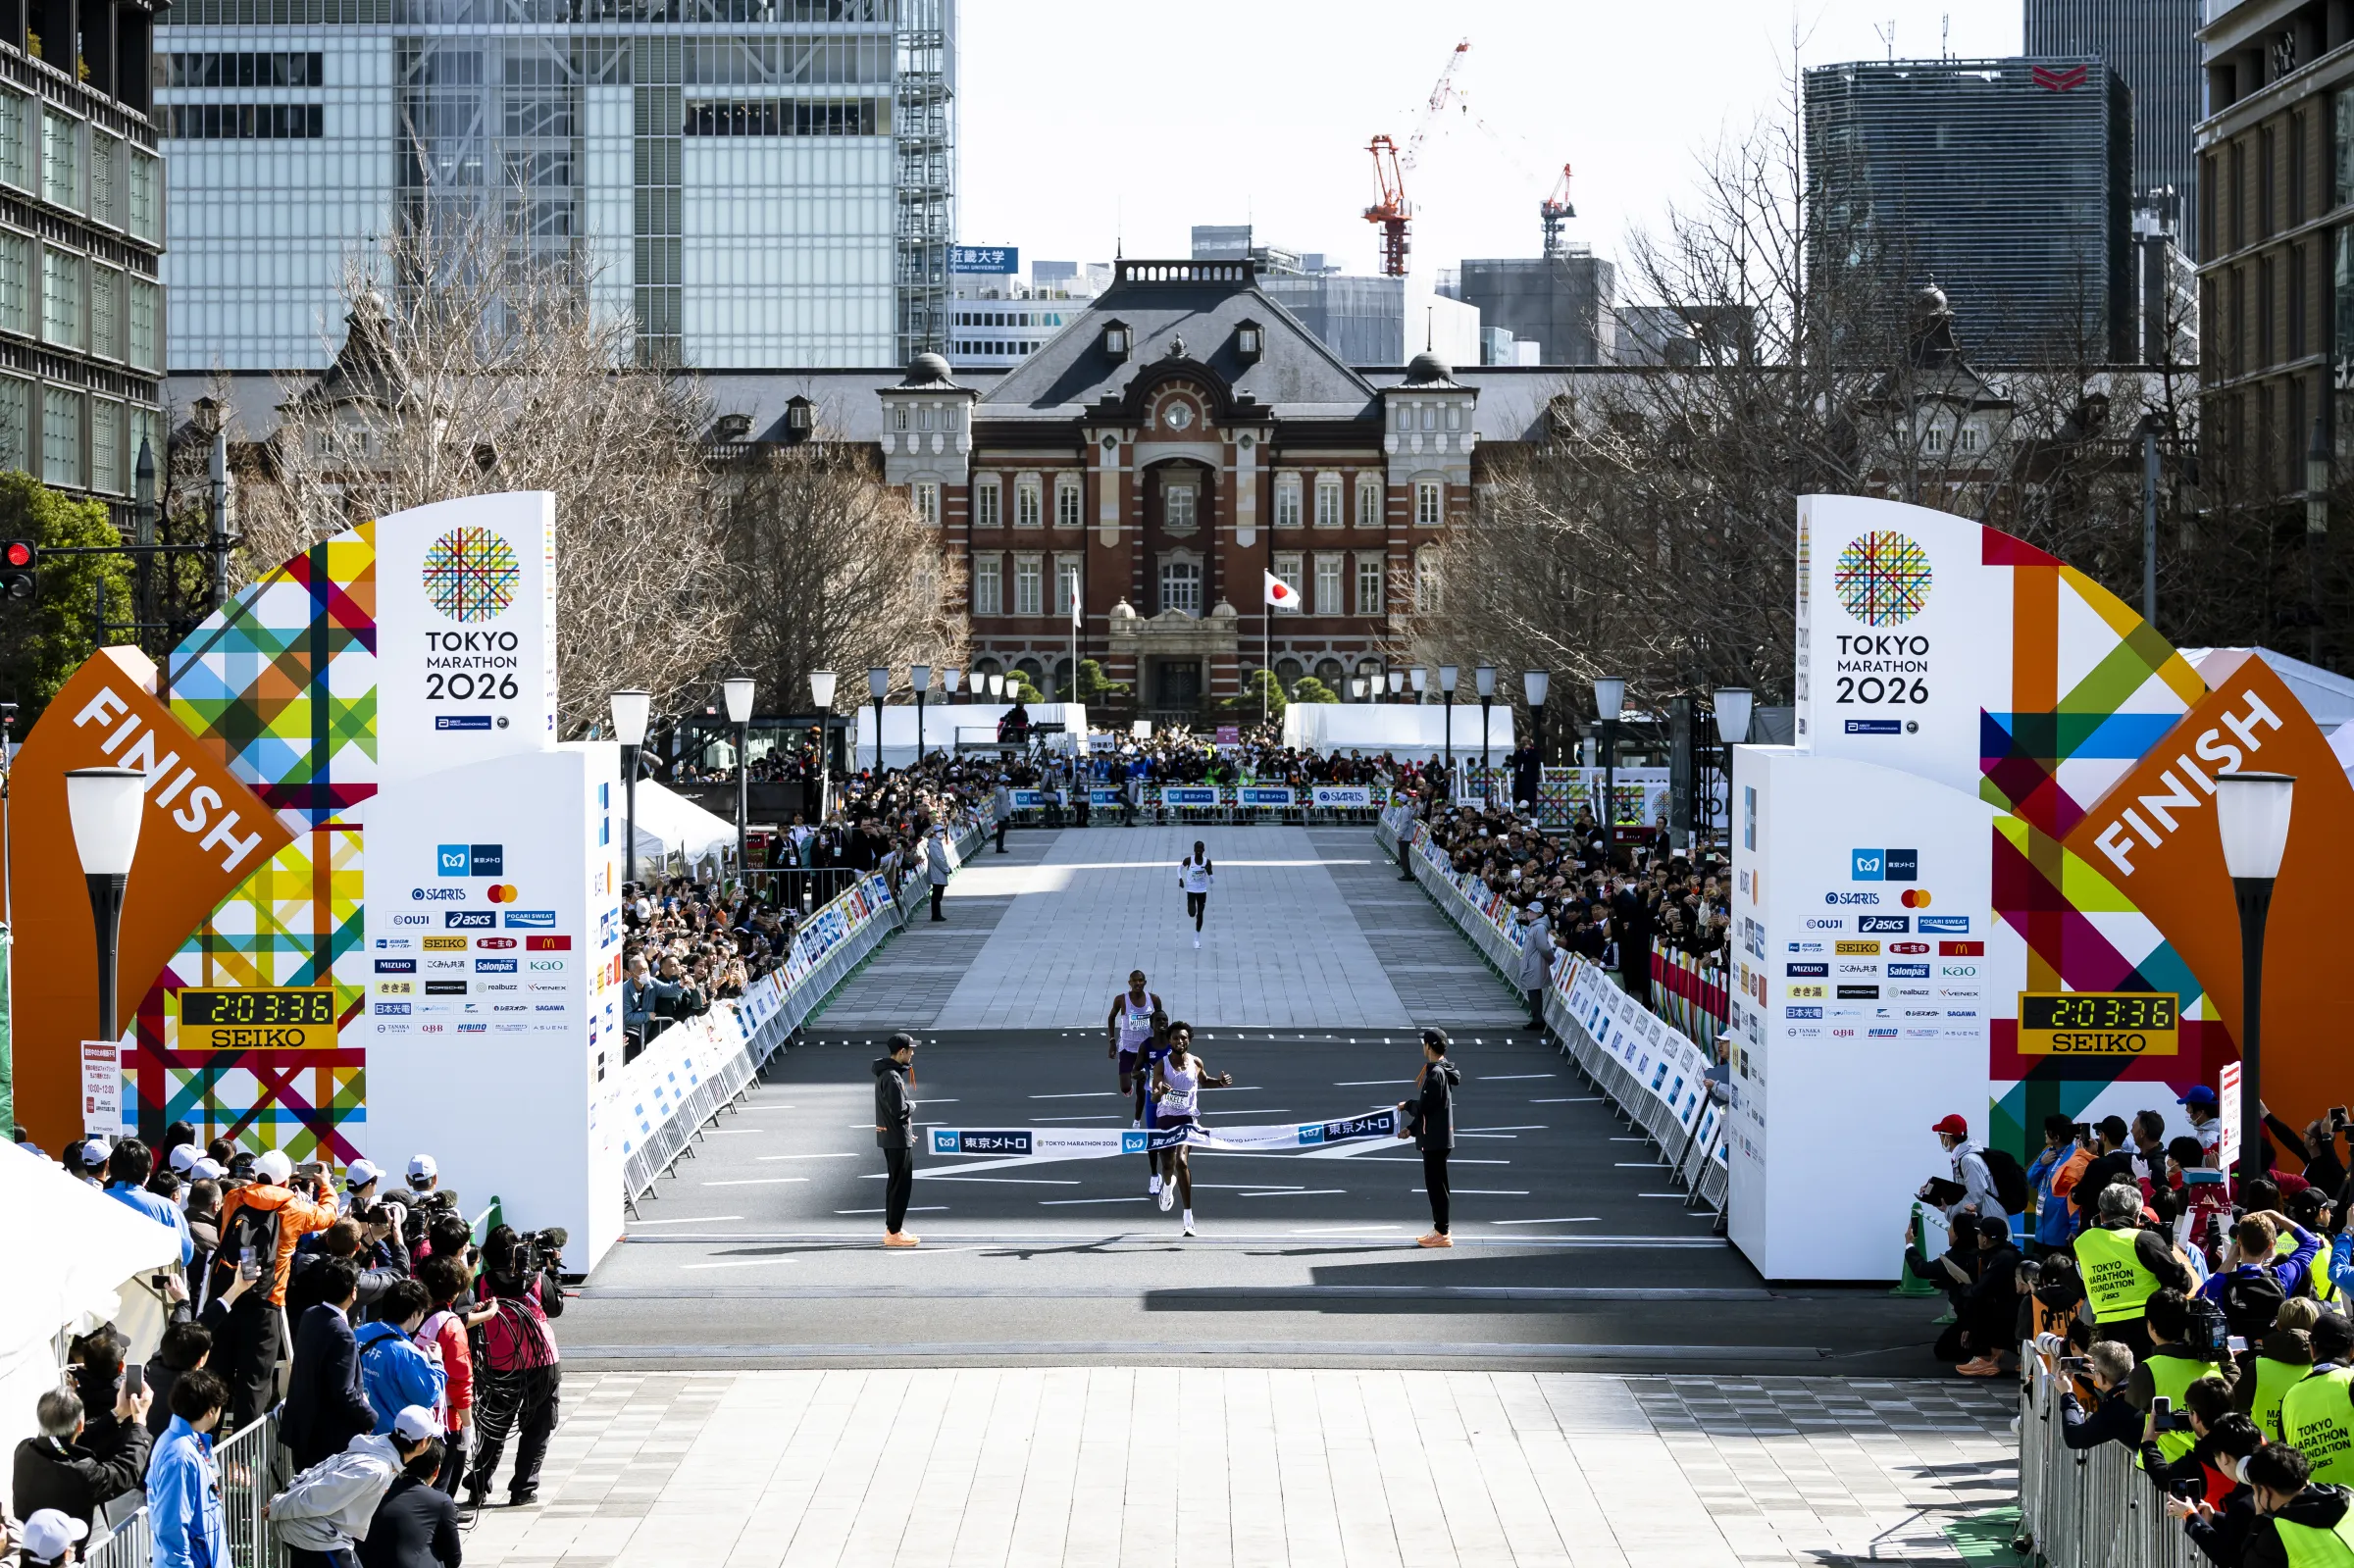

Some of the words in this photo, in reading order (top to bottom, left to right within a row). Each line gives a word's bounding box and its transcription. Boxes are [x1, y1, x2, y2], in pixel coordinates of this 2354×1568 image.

[949, 249, 1005, 263] 近畿大学
[426, 632, 519, 651] TOKYO
[1836, 635, 1929, 655] TOKYO
[427, 657, 517, 668] MARATHON
[1838, 660, 1927, 672] MARATHON
[426, 673, 518, 699] 2026
[1836, 677, 1928, 704] 2026
[73, 685, 263, 873] FINISH
[2093, 688, 2283, 877] FINISH
[404, 916, 430, 925] OUJI
[463, 915, 490, 925] asics
[1817, 920, 1843, 929] OUJI
[1875, 920, 1904, 930] asics
[1836, 943, 1879, 952] SEIKO
[477, 962, 513, 972] Salonpas
[1889, 967, 1925, 977] Salonpas
[382, 983, 410, 993] きき湯
[1792, 986, 1822, 997] きき湯
[212, 994, 329, 1022] 2:03:36
[376, 1004, 410, 1014] 日本光電
[1786, 1008, 1822, 1017] 日本光電
[2052, 999, 2169, 1027] 2:03:36
[212, 1029, 305, 1047] SEIKO
[2053, 1034, 2146, 1052] SEIKO
[1329, 1118, 1390, 1135] 東京メトロ
[964, 1138, 1027, 1148] 東京メトロ
[2276, 1241, 2299, 1250] SECURIT
[2091, 1261, 2122, 1274] TOKYO
[2090, 1279, 2135, 1293] FOUNDATION
[2297, 1418, 2332, 1438] TOKYO
[2294, 1427, 2349, 1450] ARATHON
[2306, 1440, 2351, 1459] UNDATION
[2317, 1457, 2333, 1468] asics
